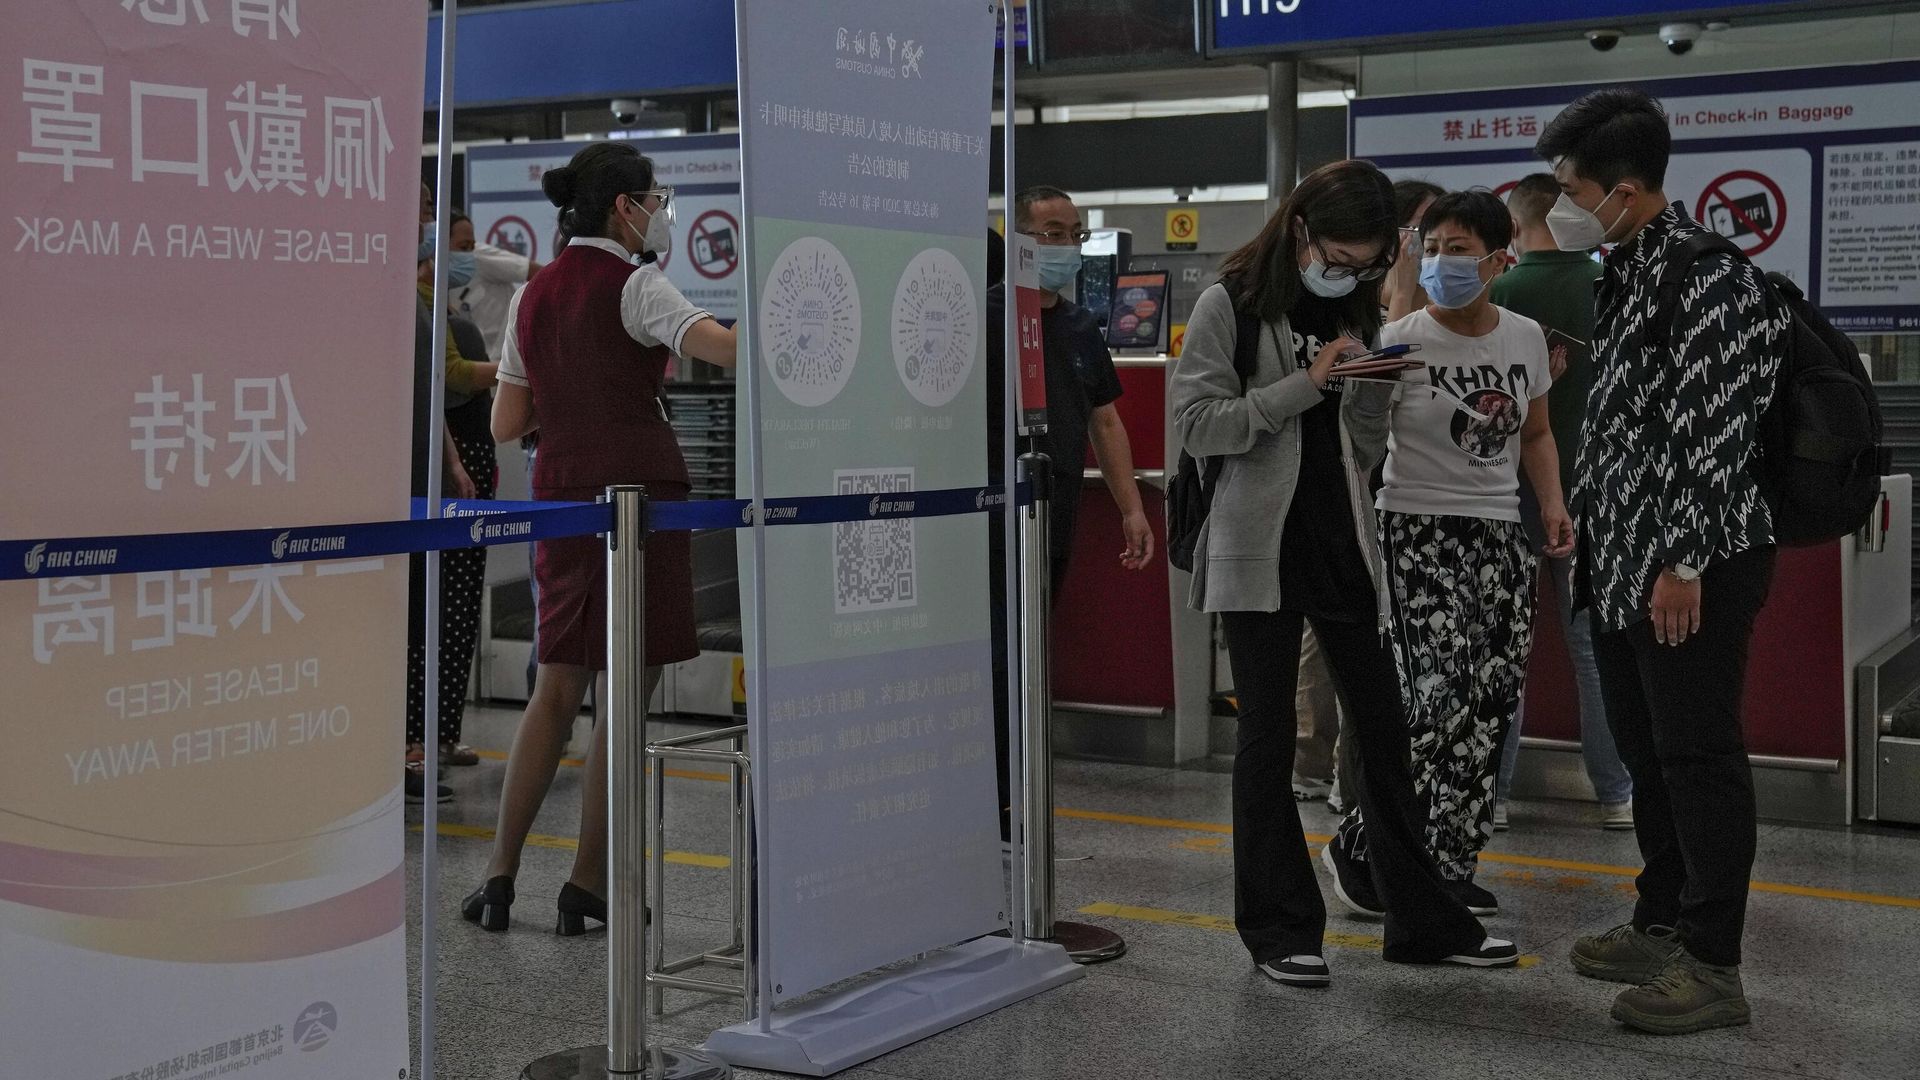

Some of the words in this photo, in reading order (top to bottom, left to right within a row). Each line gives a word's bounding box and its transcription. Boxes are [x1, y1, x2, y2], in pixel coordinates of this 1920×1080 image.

[1675, 112, 1690, 126] in
[1695, 107, 1768, 125] Check-in
[1778, 104, 1854, 122] Baggage
[1443, 116, 1537, 141] 禁止托运
[771, 507, 798, 519] CHINA
[880, 501, 893, 513] AIR
[893, 500, 915, 512] CHINA
[485, 524, 501, 538] AIR
[503, 521, 532, 536] CHINA
[289, 537, 310, 553] AIR
[312, 535, 346, 552] CHINA
[47, 550, 72, 568] AIR
[74, 548, 118, 566] CHINA
